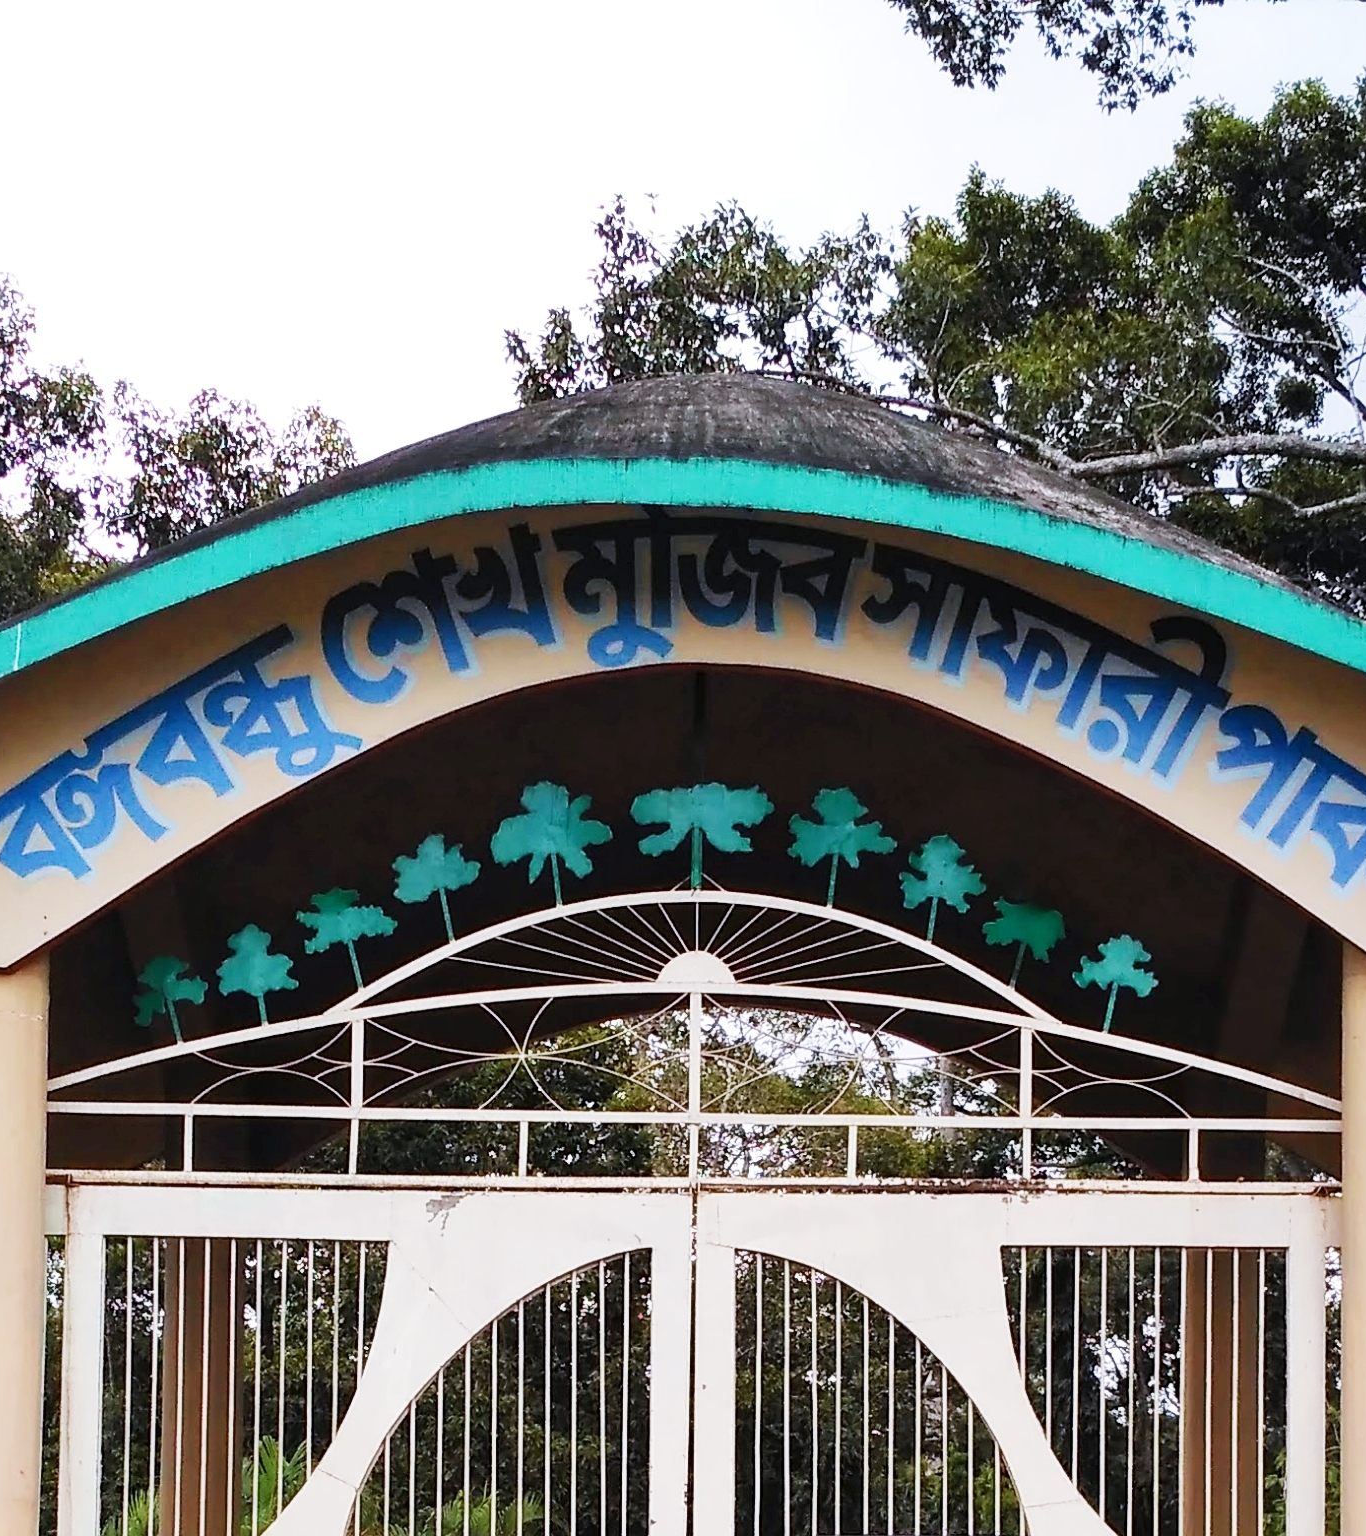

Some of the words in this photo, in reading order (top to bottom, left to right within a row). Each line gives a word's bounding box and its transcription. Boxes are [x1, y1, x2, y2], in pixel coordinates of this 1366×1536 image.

[321, 523, 557, 704] শেখ
[552, 504, 869, 668] মুজিব
[860, 540, 1232, 779] সাফারী
